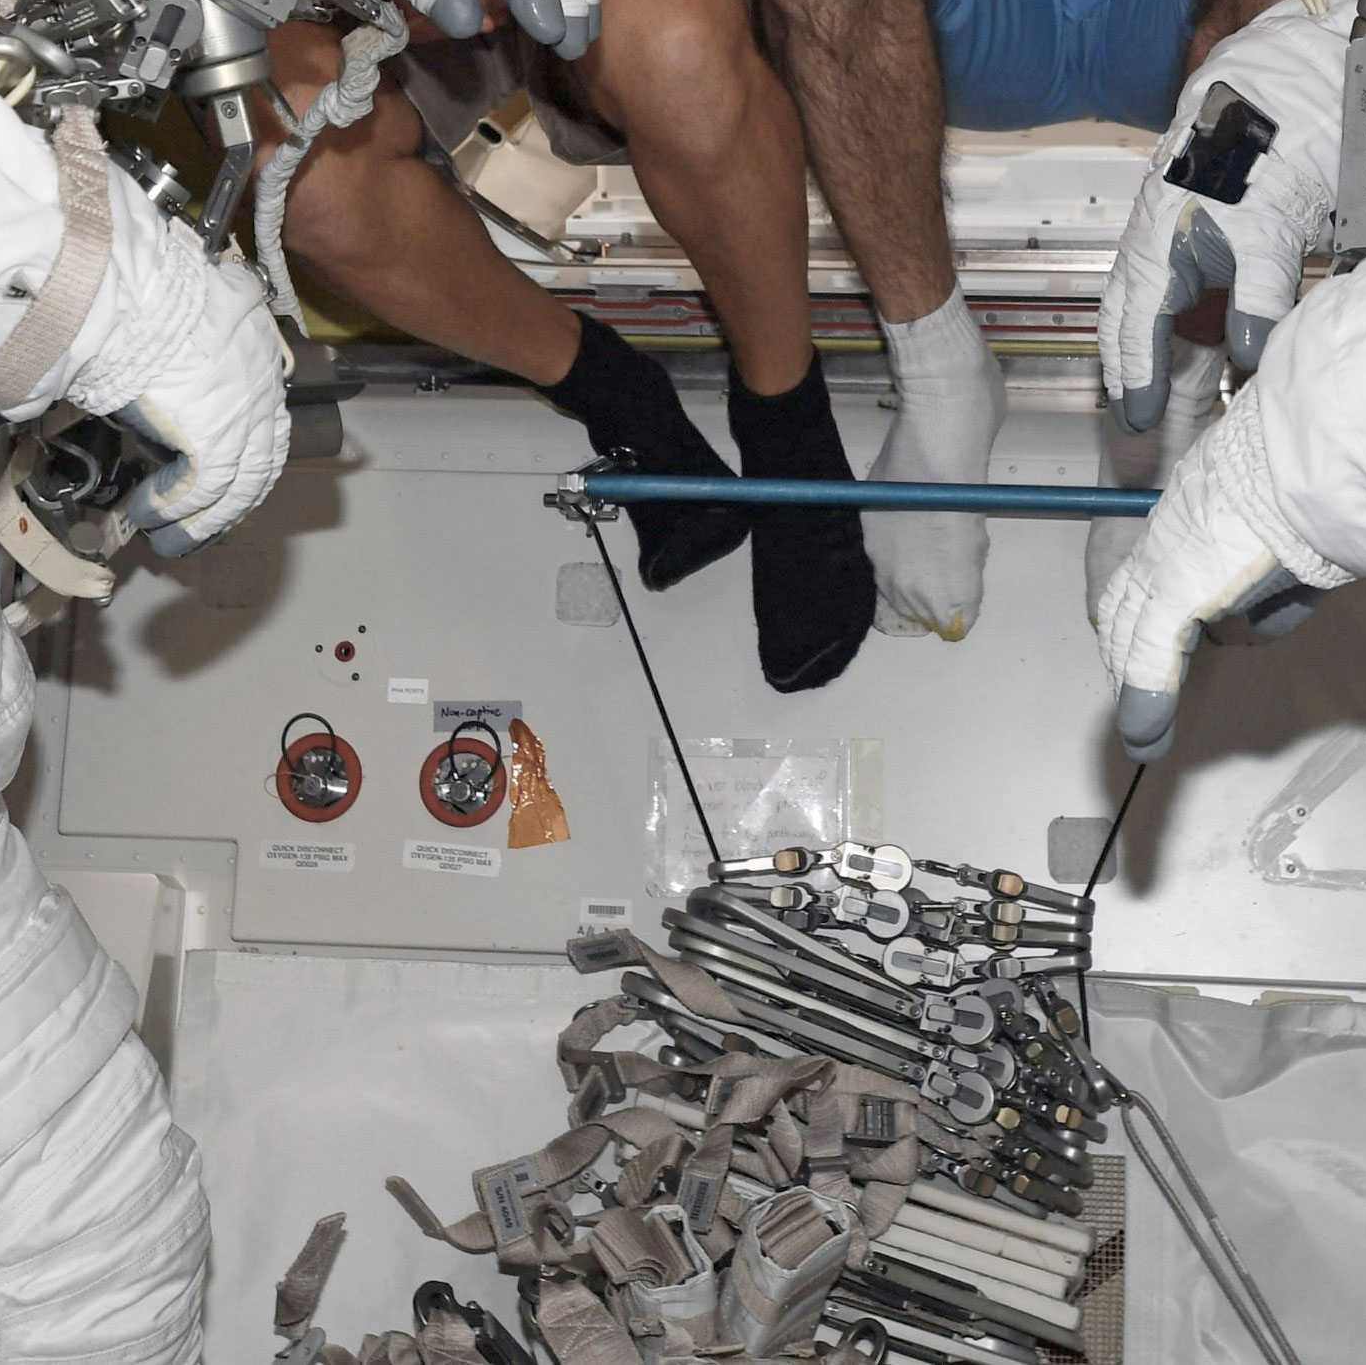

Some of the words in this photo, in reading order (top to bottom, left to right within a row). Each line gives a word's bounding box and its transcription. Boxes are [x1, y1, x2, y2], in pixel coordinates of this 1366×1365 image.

[440, 705, 503, 720] Non-captive
[272, 844, 295, 852] QUICK
[297, 845, 344, 854] DISCONNECT
[416, 845, 439, 853] QUICK
[441, 847, 489, 858] DISCONNECT
[313, 853, 330, 861] PSIG
[332, 854, 348, 862] MAX
[411, 852, 455, 863] OXYGEN-135
[457, 856, 474, 865] PSIG
[495, 1185, 506, 1204] S/N
